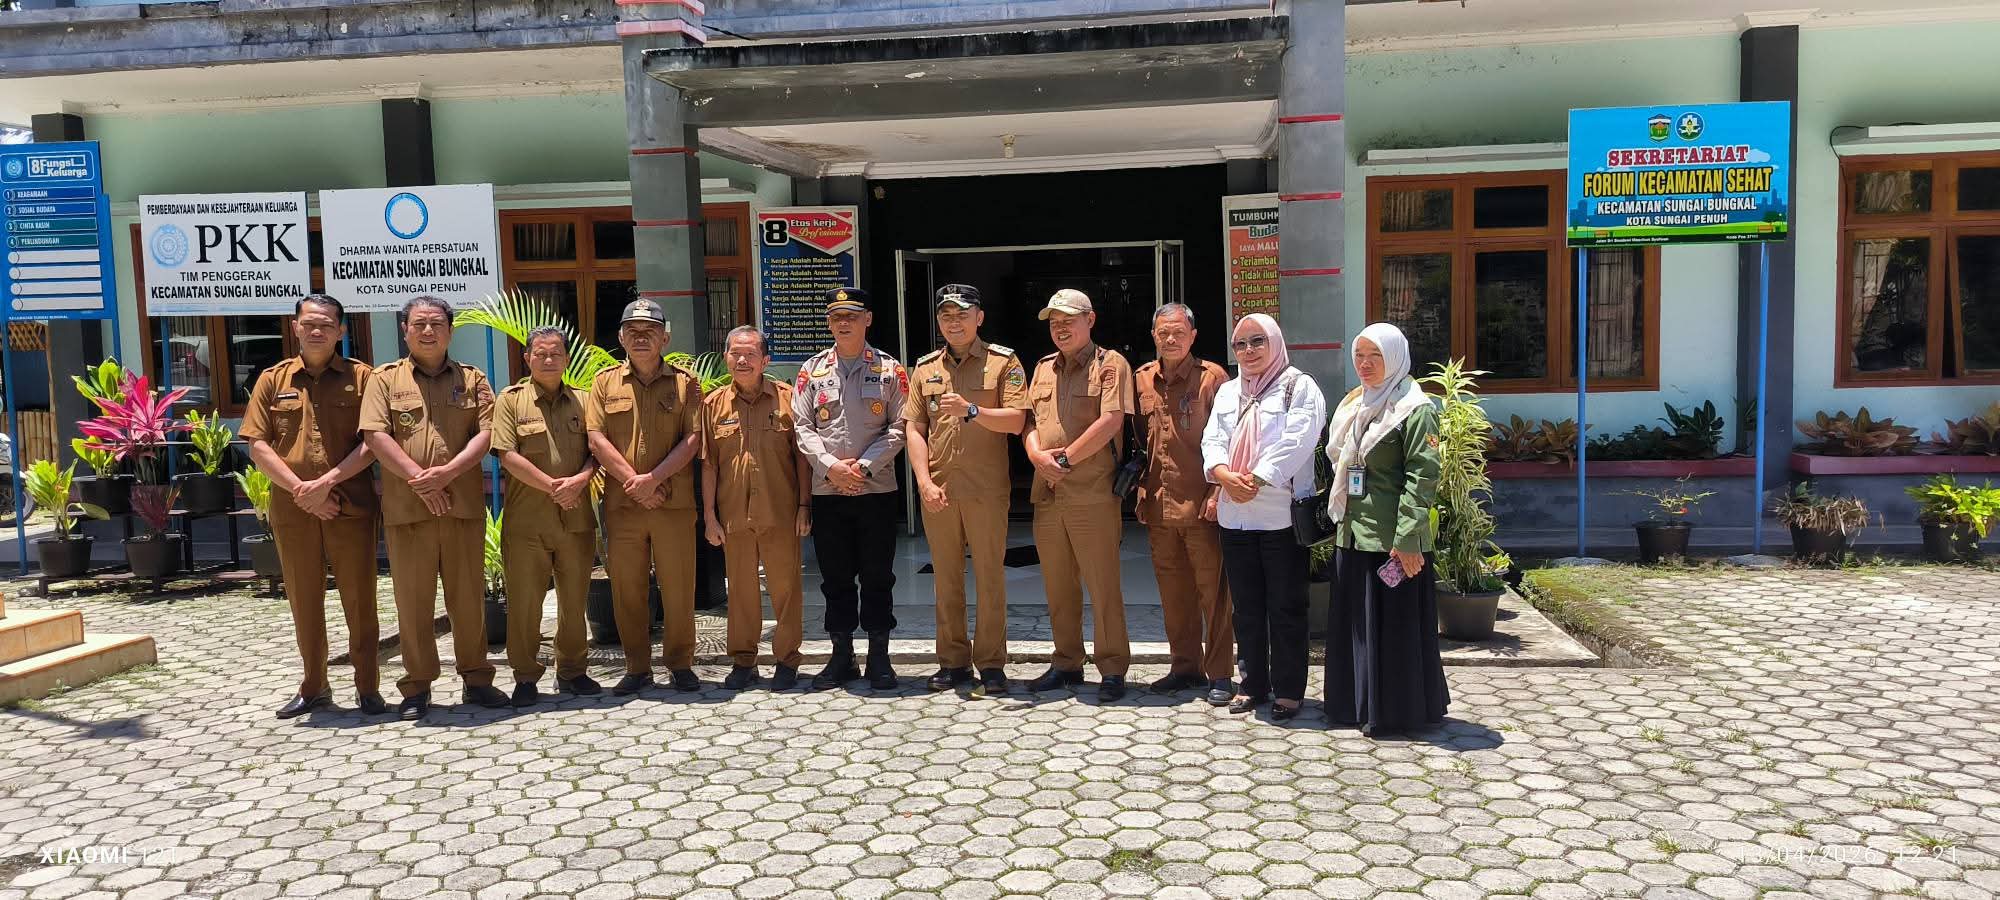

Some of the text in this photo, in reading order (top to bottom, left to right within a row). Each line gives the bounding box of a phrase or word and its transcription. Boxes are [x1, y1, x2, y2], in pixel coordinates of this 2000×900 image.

[1608, 146, 1749, 167] SEKRETARIAT
[47, 168, 88, 178] Keluarga
[1584, 168, 1773, 197] FORUM KECAMATAN SEHAT
[147, 202, 298, 214] PEMBERDAYAAN DAN KESEJAHTERAAN KELUARGA
[1598, 197, 1757, 214] KECAMATAN SUNGAI BUNGKAL
[1233, 211, 1279, 222] TUMBUHK
[1626, 214, 1728, 226] KOTA SUNGAI PENUH
[814, 219, 837, 228] Kerja
[763, 218, 789, 246] 8
[800, 227, 848, 239] Profesional
[1249, 224, 1278, 237] Buda
[194, 223, 300, 264] PKK
[340, 243, 479, 256] DHARMA WANITA PERSATUAN
[1240, 256, 1277, 266] Terlambat
[333, 257, 488, 280] KECAMATAN SUNGAI BUNGKAL
[180, 271, 271, 281] TIM PENGGERAK
[1241, 270, 1277, 280] Tidak ikut
[152, 284, 304, 299] KECAMATAN SUNGAI BUNGKAL
[357, 283, 466, 294] KOTA SUNGAI PENUH
[1241, 284, 1261, 293] Tidak
[1242, 297, 1279, 308] Cepat pul
